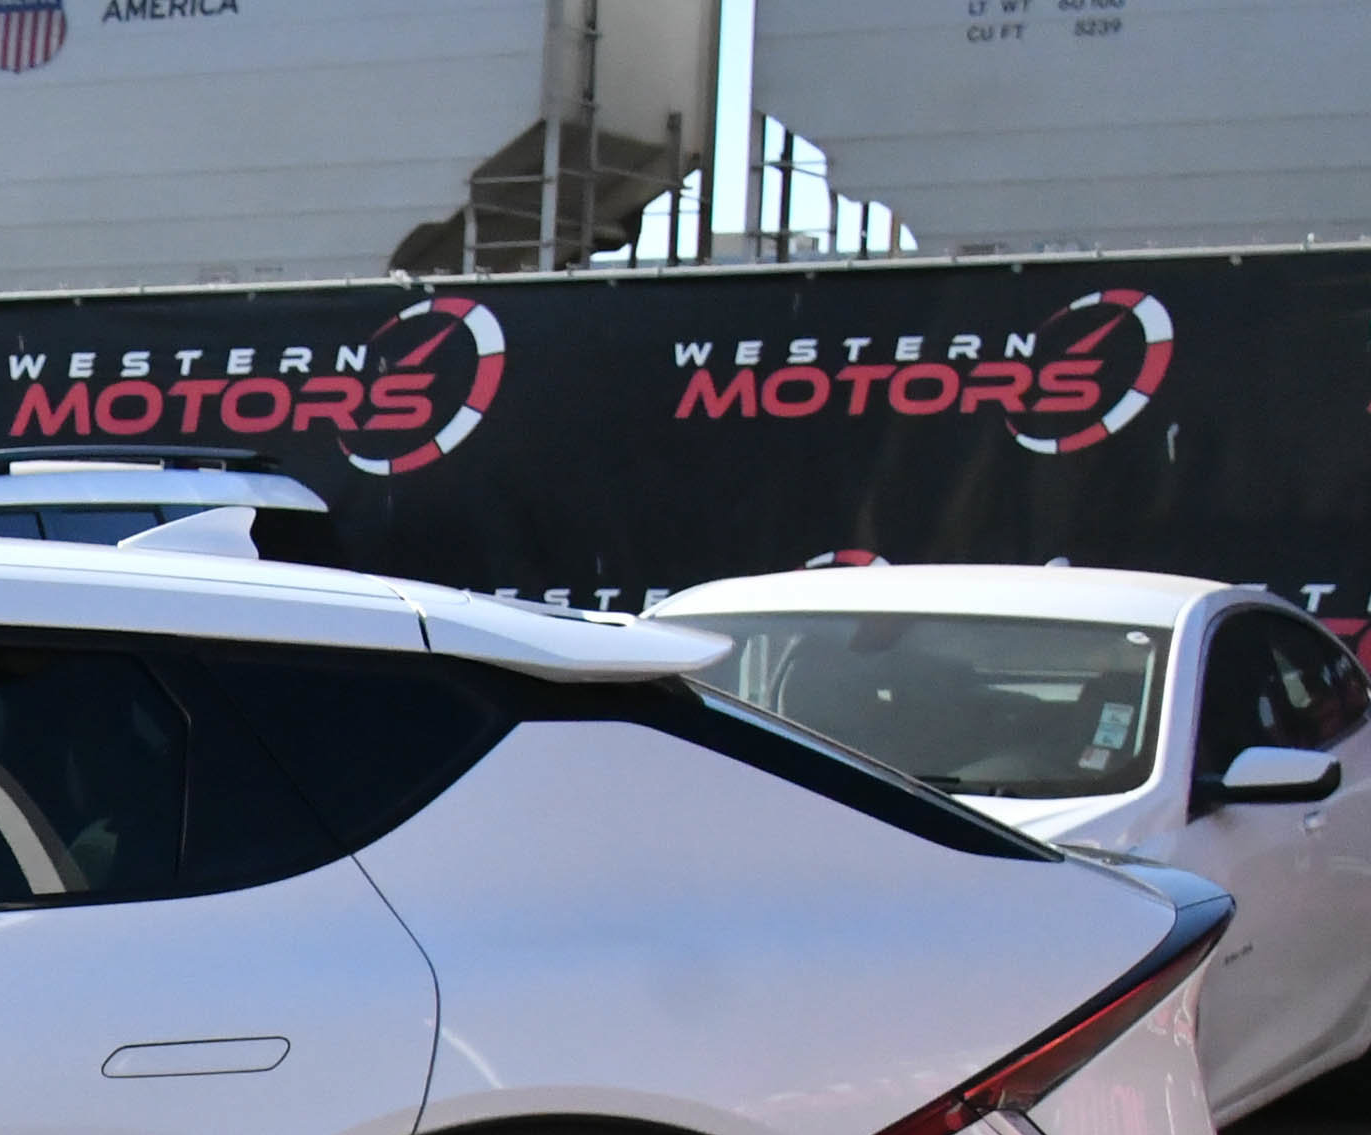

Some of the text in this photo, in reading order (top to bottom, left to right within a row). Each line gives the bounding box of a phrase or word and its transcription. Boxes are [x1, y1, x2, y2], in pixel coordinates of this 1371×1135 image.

[8, 344, 367, 380] WESTERN
[674, 333, 1036, 367] WESTERN
[9, 373, 436, 437] MOTORS
[674, 359, 1104, 419] MOTORS
